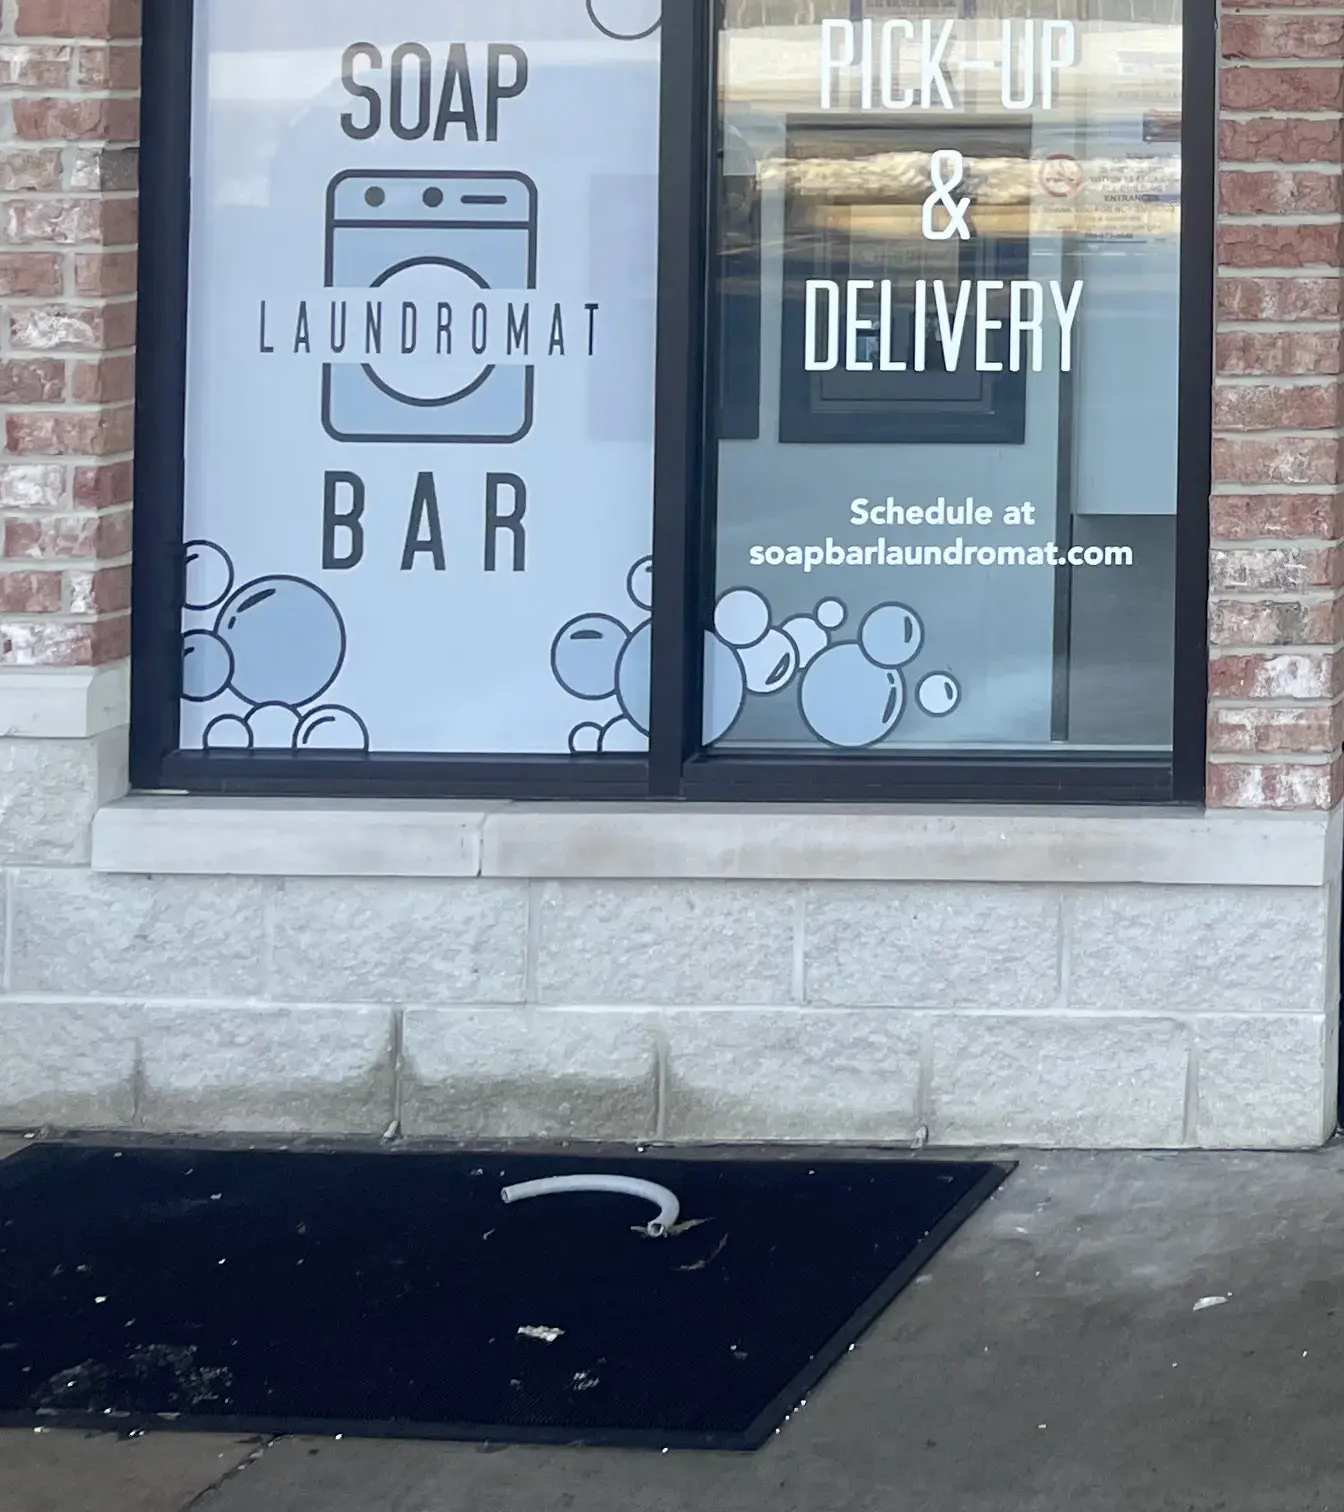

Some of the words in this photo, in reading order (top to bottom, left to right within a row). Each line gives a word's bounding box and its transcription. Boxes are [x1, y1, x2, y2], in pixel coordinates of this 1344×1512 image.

[341, 42, 529, 142] SOAP
[819, 18, 1077, 110] PICK-UP
[921, 150, 971, 241] &
[259, 301, 601, 356] LAUNDROMAT
[804, 279, 1083, 373] DELIVERY
[321, 471, 528, 572] BAR
[749, 538, 1133, 571] soapbarlaundromat.com
[850, 498, 993, 527] Schedule
[1001, 500, 1035, 527] at
